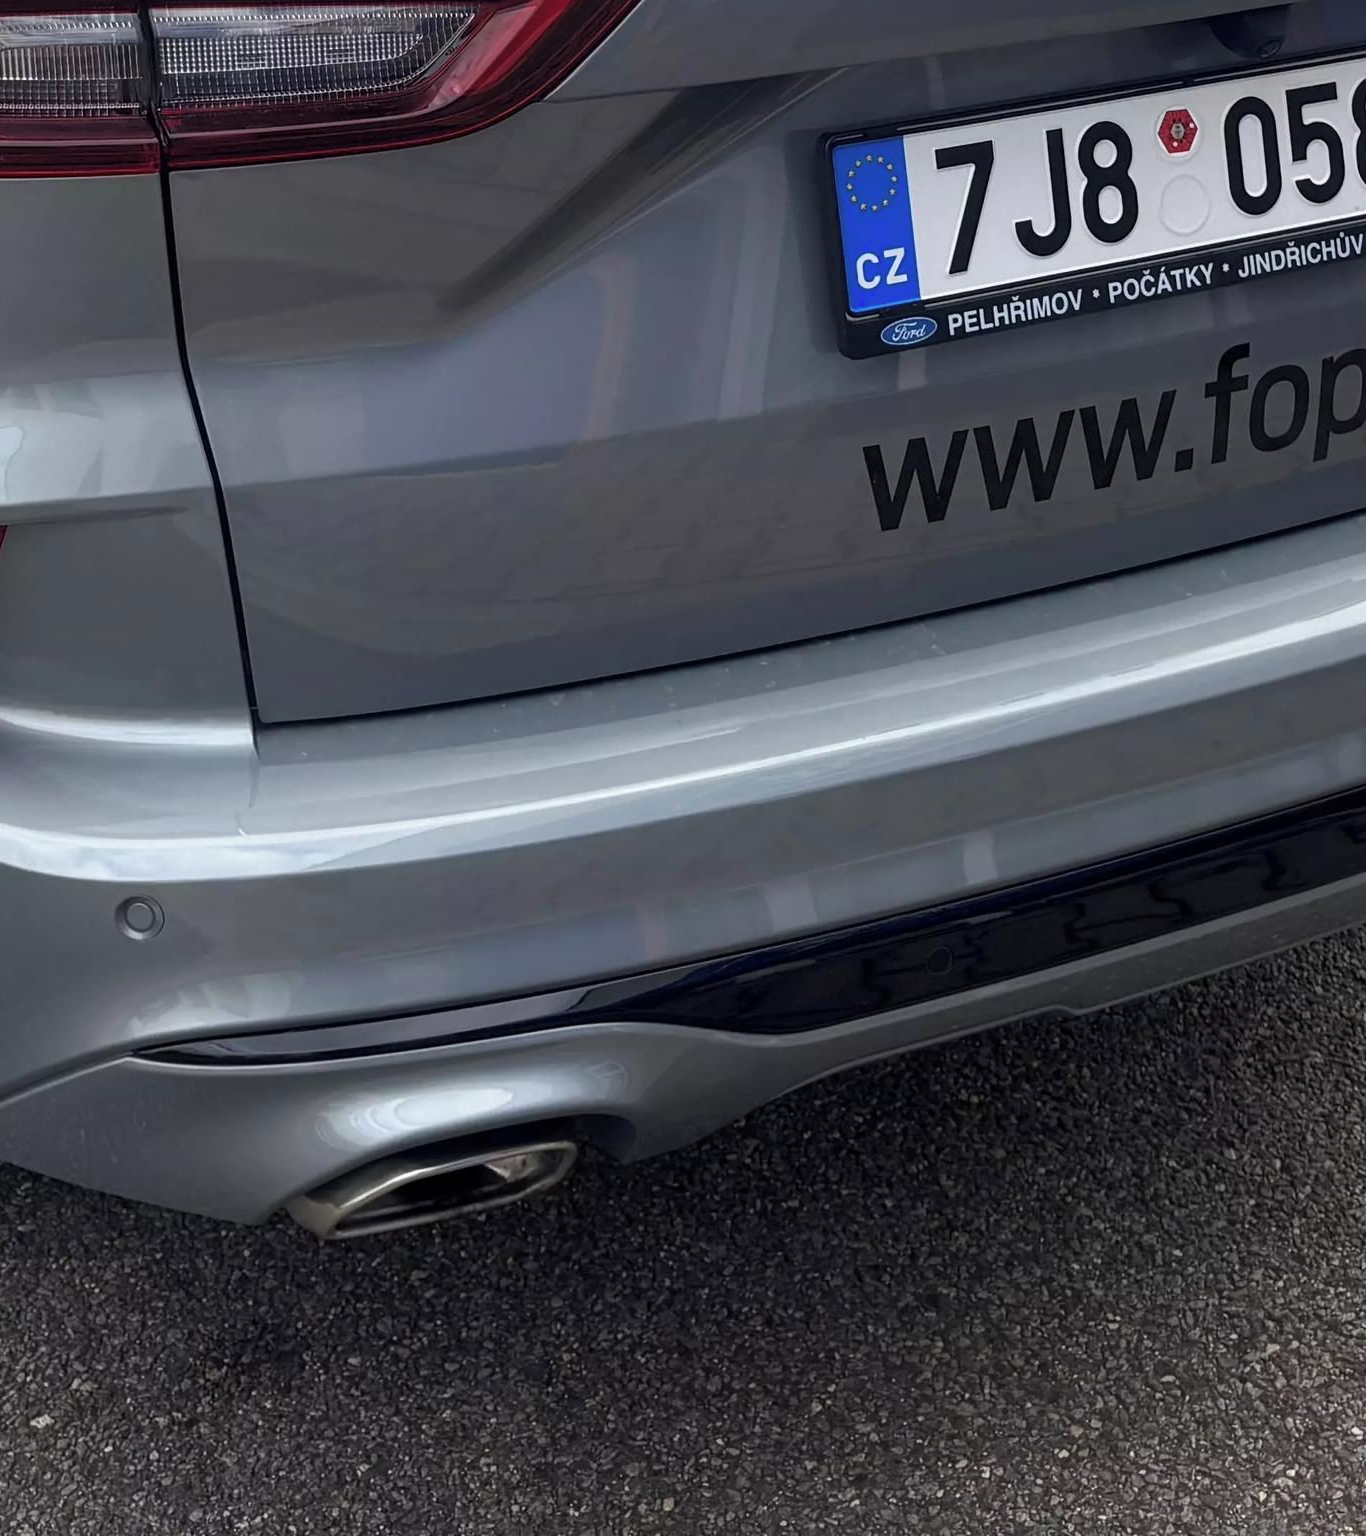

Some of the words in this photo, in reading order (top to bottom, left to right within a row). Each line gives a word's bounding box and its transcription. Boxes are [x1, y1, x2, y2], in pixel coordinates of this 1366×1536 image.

[935, 119, 1140, 276] 7J8
[855, 245, 909, 291] CZ
[948, 287, 1084, 337] PELHŘIMOV
[1108, 261, 1215, 304] POČÁTKY
[1238, 227, 1365, 279] JINDŘICHŮV
